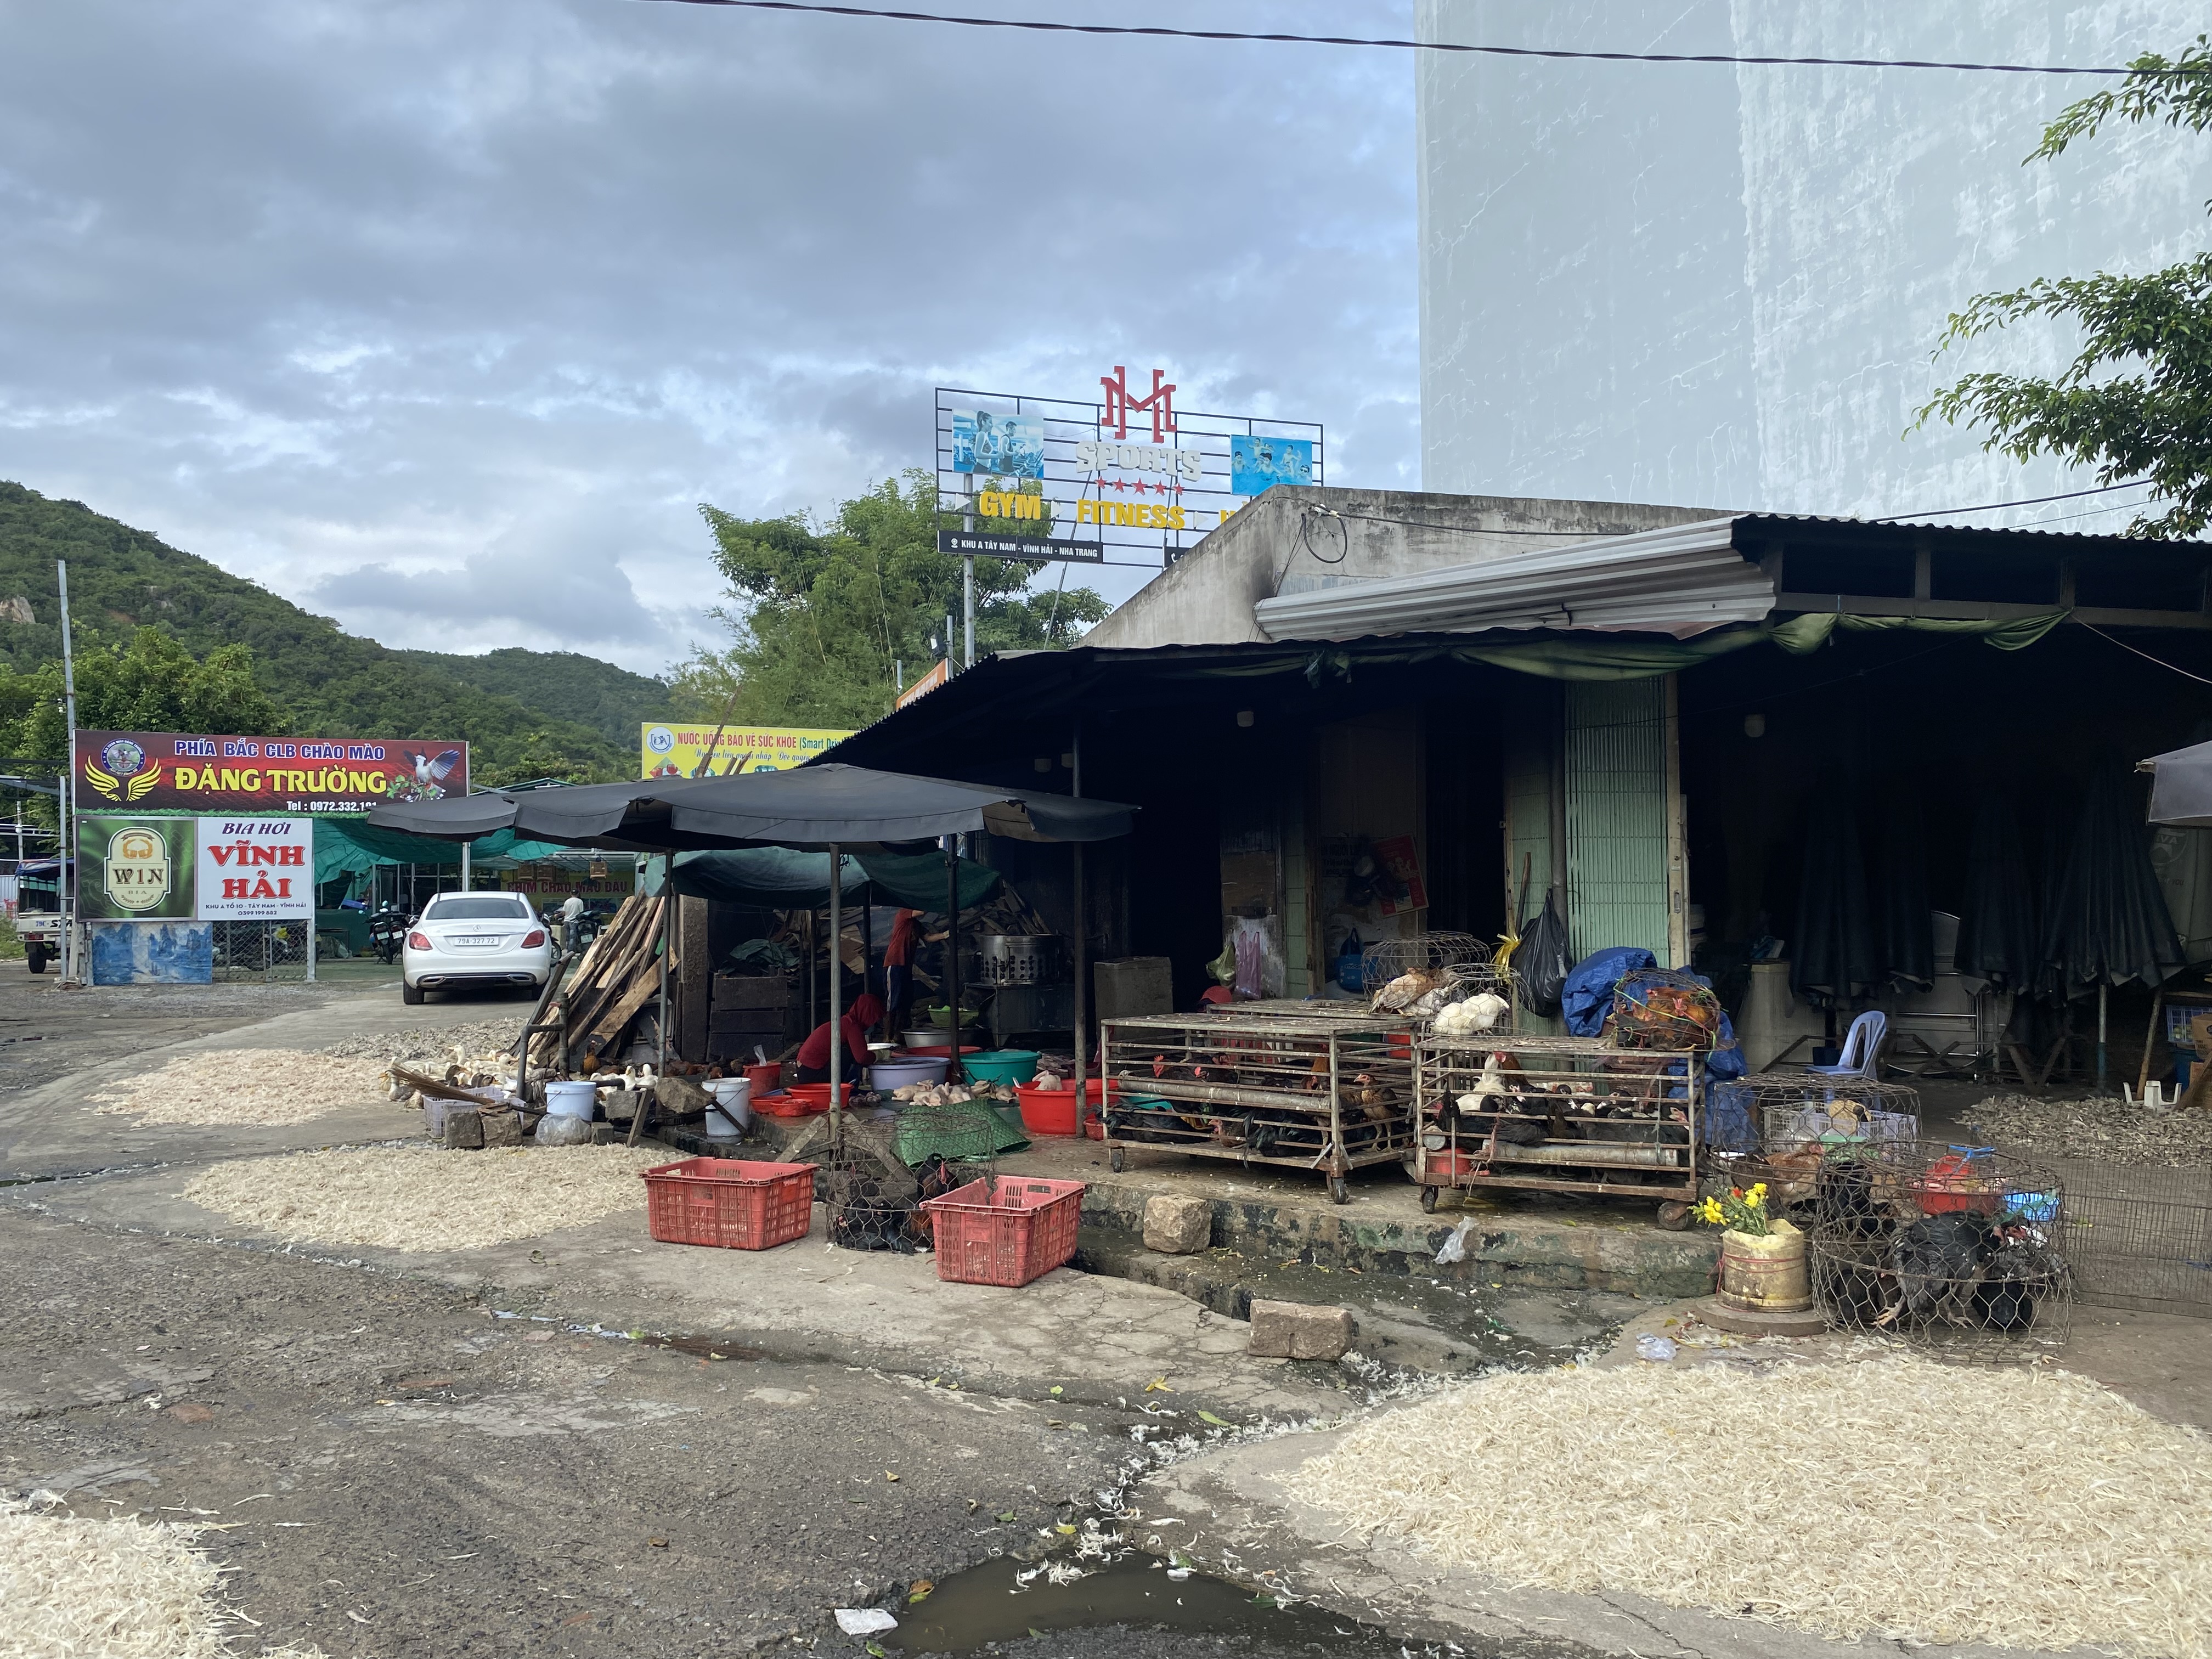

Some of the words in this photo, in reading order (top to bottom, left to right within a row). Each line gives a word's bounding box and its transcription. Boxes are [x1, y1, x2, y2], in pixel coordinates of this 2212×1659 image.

[1076, 440, 1202, 482] SPORTS
[979, 492, 1041, 520] GYM
[1076, 499, 1185, 530] FITNESS
[961, 540, 976, 549] KHU
[978, 541, 983, 549] A
[985, 539, 997, 550] TÂY
[999, 543, 1016, 551] NAM
[1023, 543, 1039, 553] VĨNH
[1041, 544, 1053, 554] HẢI
[1075, 549, 1097, 557] TRANG
[175, 738, 217, 757] PHÍA
[224, 738, 259, 757] BẮC
[265, 743, 296, 759] CLB
[300, 742, 345, 760] CHÀO
[348, 743, 385, 760] MÀO
[678, 730, 700, 745] NƯỚC
[758, 733, 774, 748] SỨC
[799, 737, 824, 751] (Smart
[175, 763, 262, 795] ĐẶNG
[266, 764, 387, 794] TRƯỜNG
[286, 800, 301, 811] Tel
[222, 823, 255, 834] BIA
[258, 822, 291, 834] HƠI
[207, 839, 306, 867] VĨNH
[221, 870, 292, 900] HẢI
